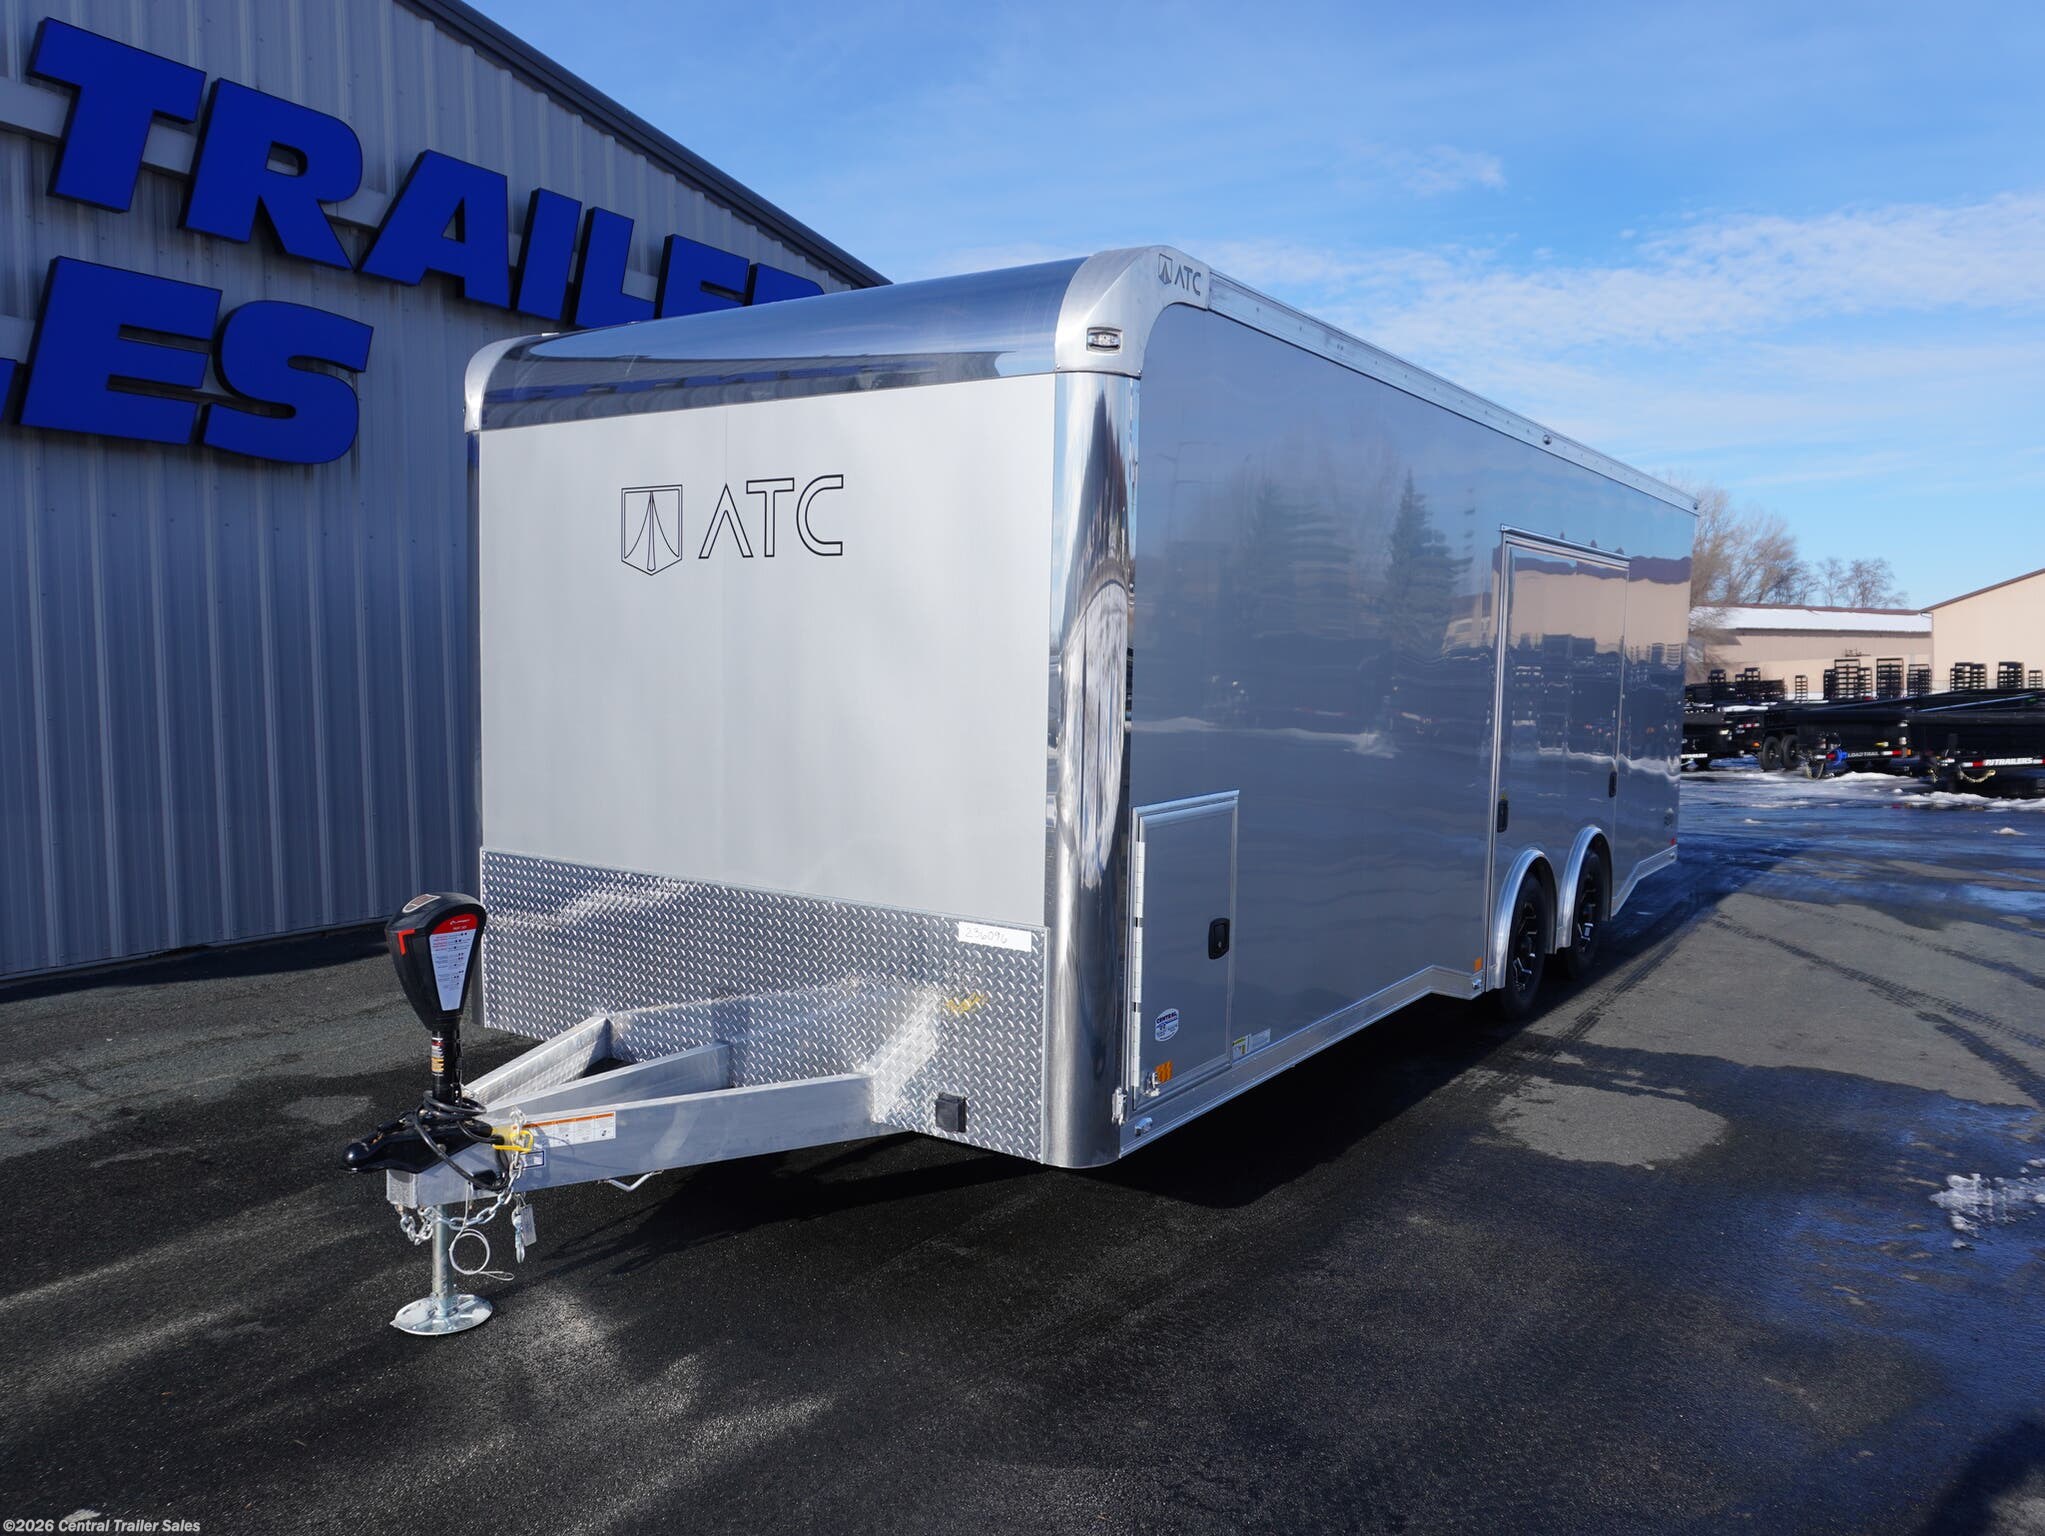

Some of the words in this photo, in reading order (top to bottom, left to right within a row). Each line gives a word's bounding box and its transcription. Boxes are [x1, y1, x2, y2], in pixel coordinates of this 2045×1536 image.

[1174, 264, 1202, 297] ATC
[0, 255, 374, 465] ES
[698, 474, 844, 559] ATC
